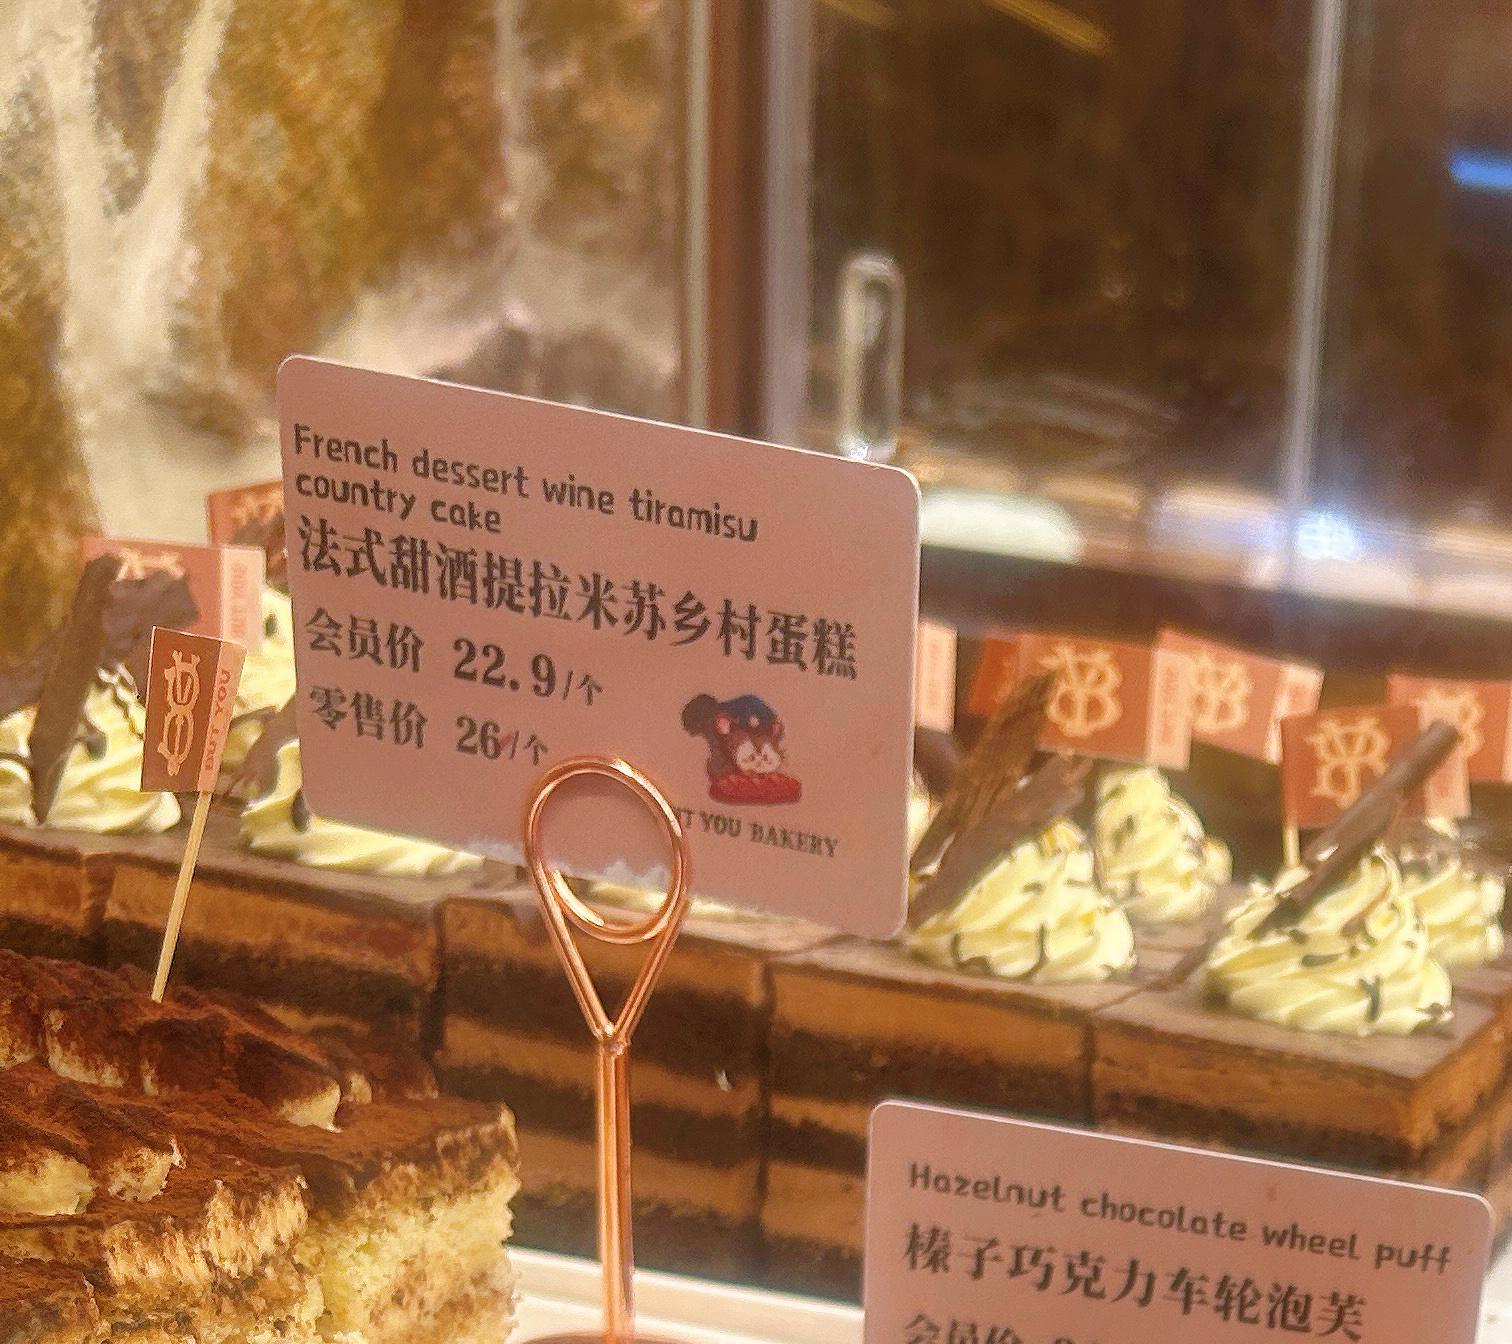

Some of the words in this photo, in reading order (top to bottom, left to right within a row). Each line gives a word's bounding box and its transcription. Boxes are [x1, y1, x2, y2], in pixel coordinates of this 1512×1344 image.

[294, 424, 398, 473] French
[412, 447, 529, 498] dessert
[543, 474, 614, 515] wine
[628, 490, 758, 543] tiramisu
[295, 471, 415, 519] country
[431, 497, 501, 533] cake
[298, 514, 857, 681] 法式甜酒提拉米苏乡村蛋糕
[306, 607, 424, 672] 会员价
[215, 668, 231, 716] YOU
[310, 686, 428, 749] 零售价
[700, 810, 741, 837] YOU
[750, 822, 840, 857] BAKERY
[909, 1162, 1066, 1213] Hazelnut
[1081, 1190, 1248, 1243] chocolate
[1262, 1223, 1358, 1261] wheel
[1374, 1237, 1452, 1275] puff
[902, 1222, 1366, 1344] 榛子巧克力车轮泡芙
